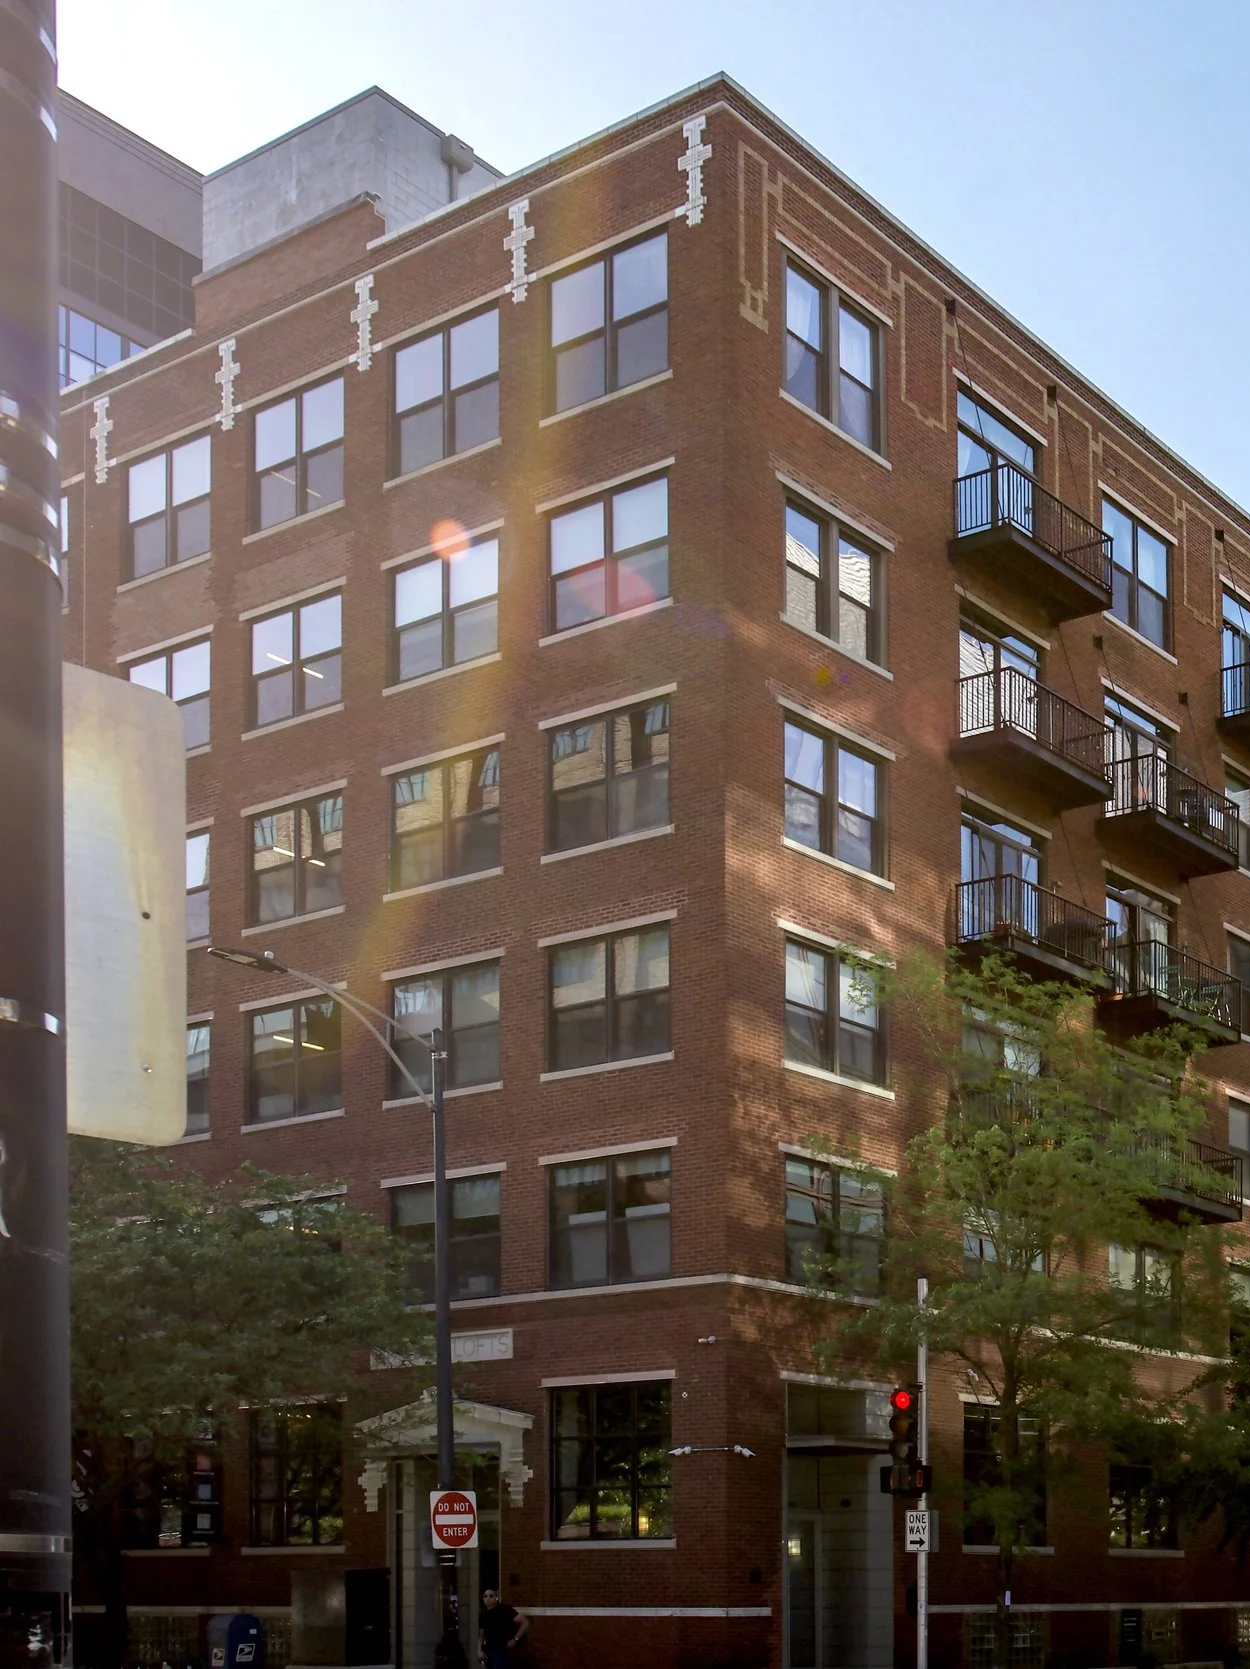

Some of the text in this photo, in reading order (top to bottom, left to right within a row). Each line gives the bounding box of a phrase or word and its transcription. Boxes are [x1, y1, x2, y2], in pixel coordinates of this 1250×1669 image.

[452, 1334, 509, 1358] LOFTS
[438, 1502, 470, 1512] DO NOT
[909, 1514, 926, 1524] ONE
[443, 1527, 468, 1537] ENTER
[909, 1525, 926, 1535] WAY
